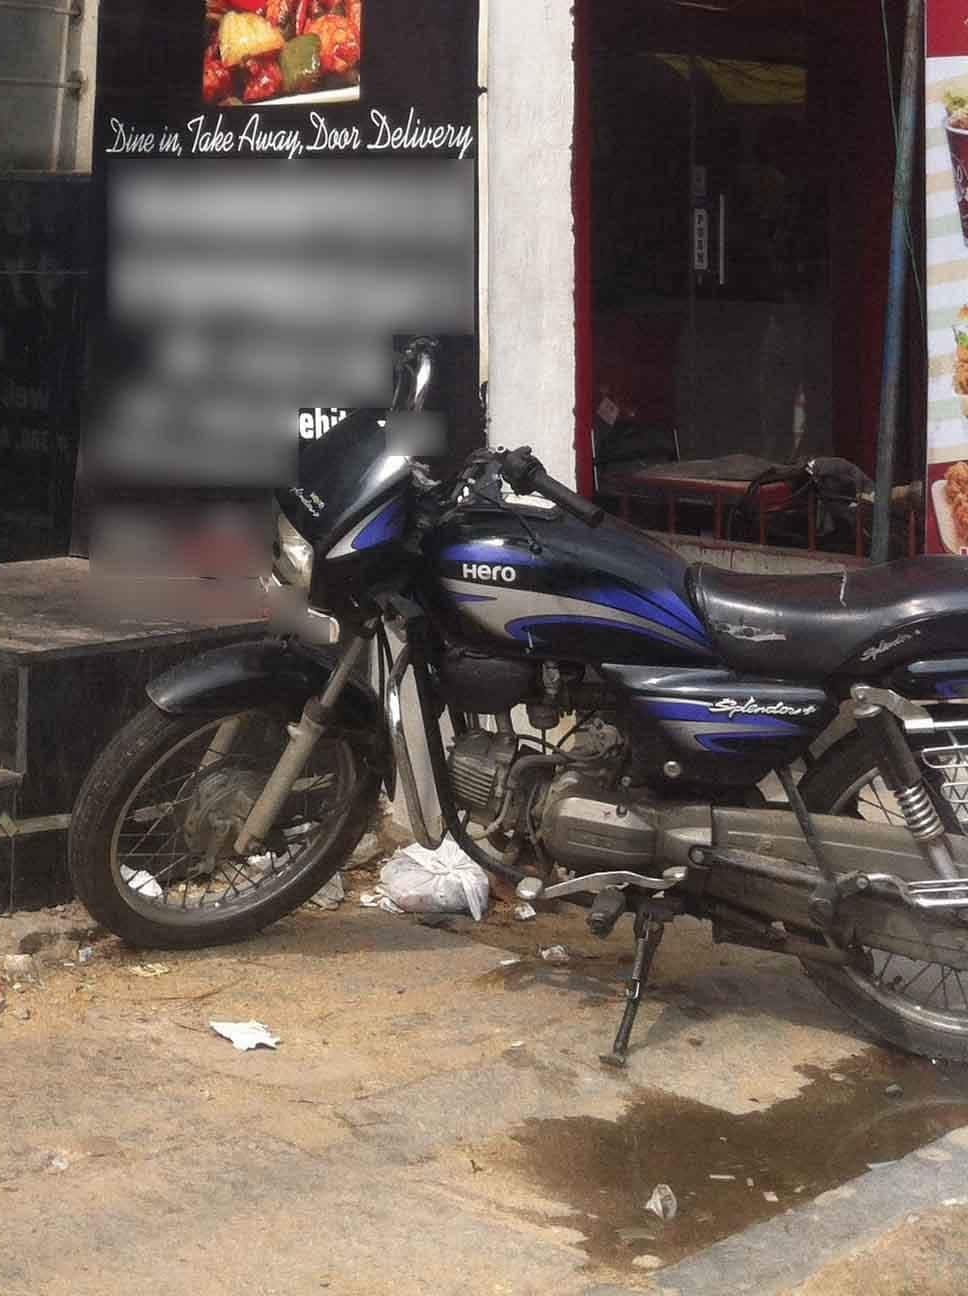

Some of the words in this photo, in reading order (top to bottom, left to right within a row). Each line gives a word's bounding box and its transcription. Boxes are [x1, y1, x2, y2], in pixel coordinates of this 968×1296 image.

[105, 117, 155, 154] Dine
[159, 125, 183, 157] in,
[187, 112, 233, 153] Take
[237, 112, 303, 160] Away,
[306, 111, 362, 151] Door
[366, 106, 474, 160] Delivery
[462, 562, 517, 583] Hero
